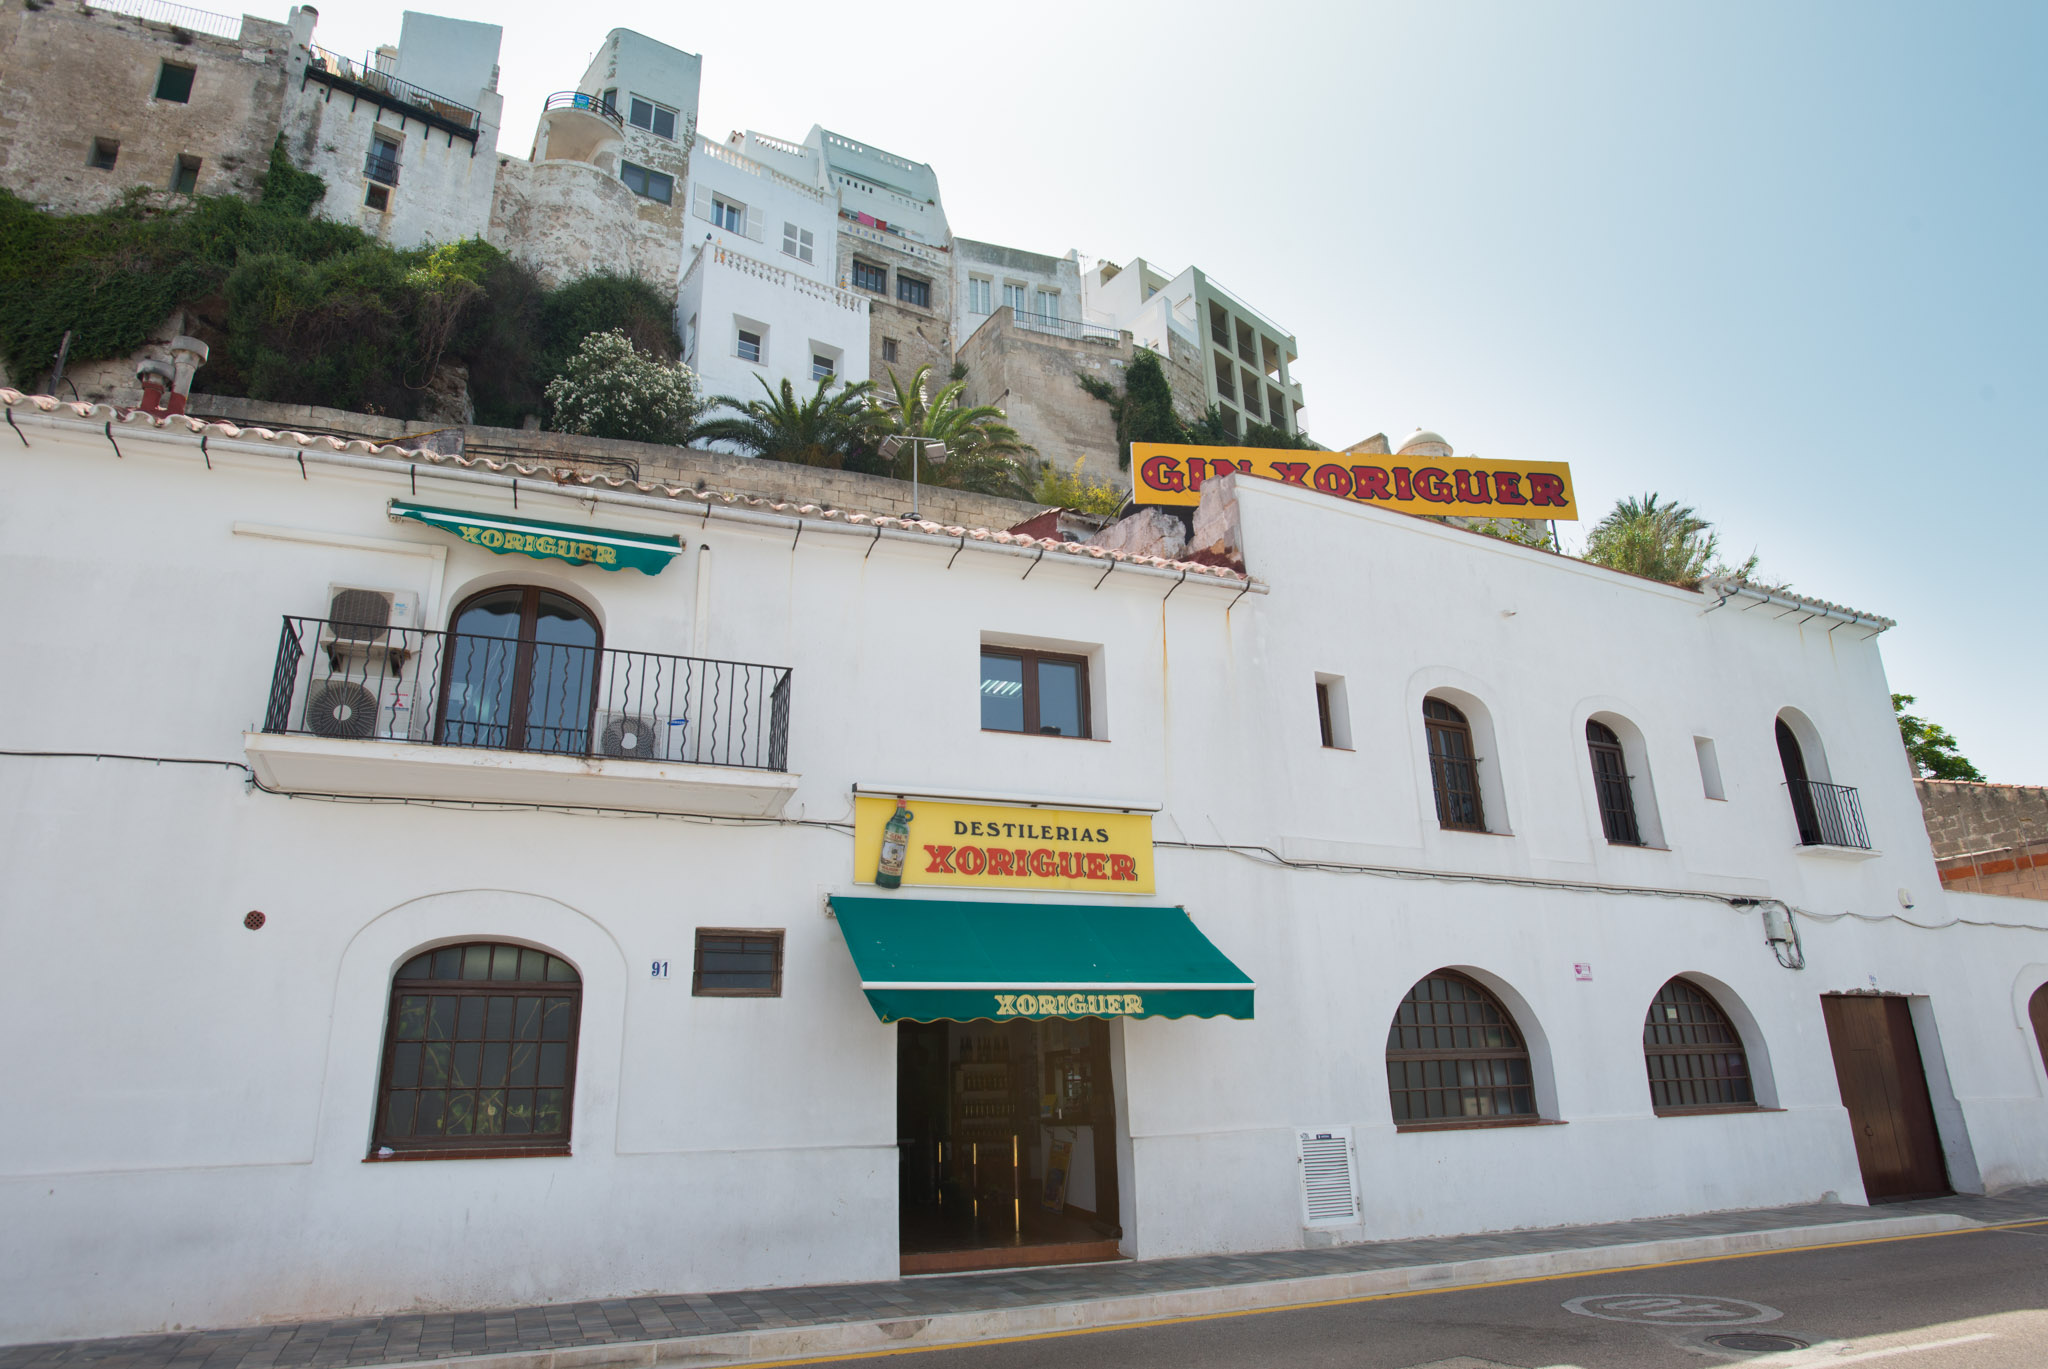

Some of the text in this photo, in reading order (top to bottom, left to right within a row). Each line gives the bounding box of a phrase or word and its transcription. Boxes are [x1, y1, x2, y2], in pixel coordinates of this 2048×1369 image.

[1269, 462, 1569, 507] XORIGUER
[458, 525, 617, 564] XORIGUER
[953, 820, 1110, 843] DESTILERIAS
[923, 844, 1138, 881] XORIGUER
[651, 961, 669, 977] 91
[994, 993, 1144, 1016] XORIGUER
